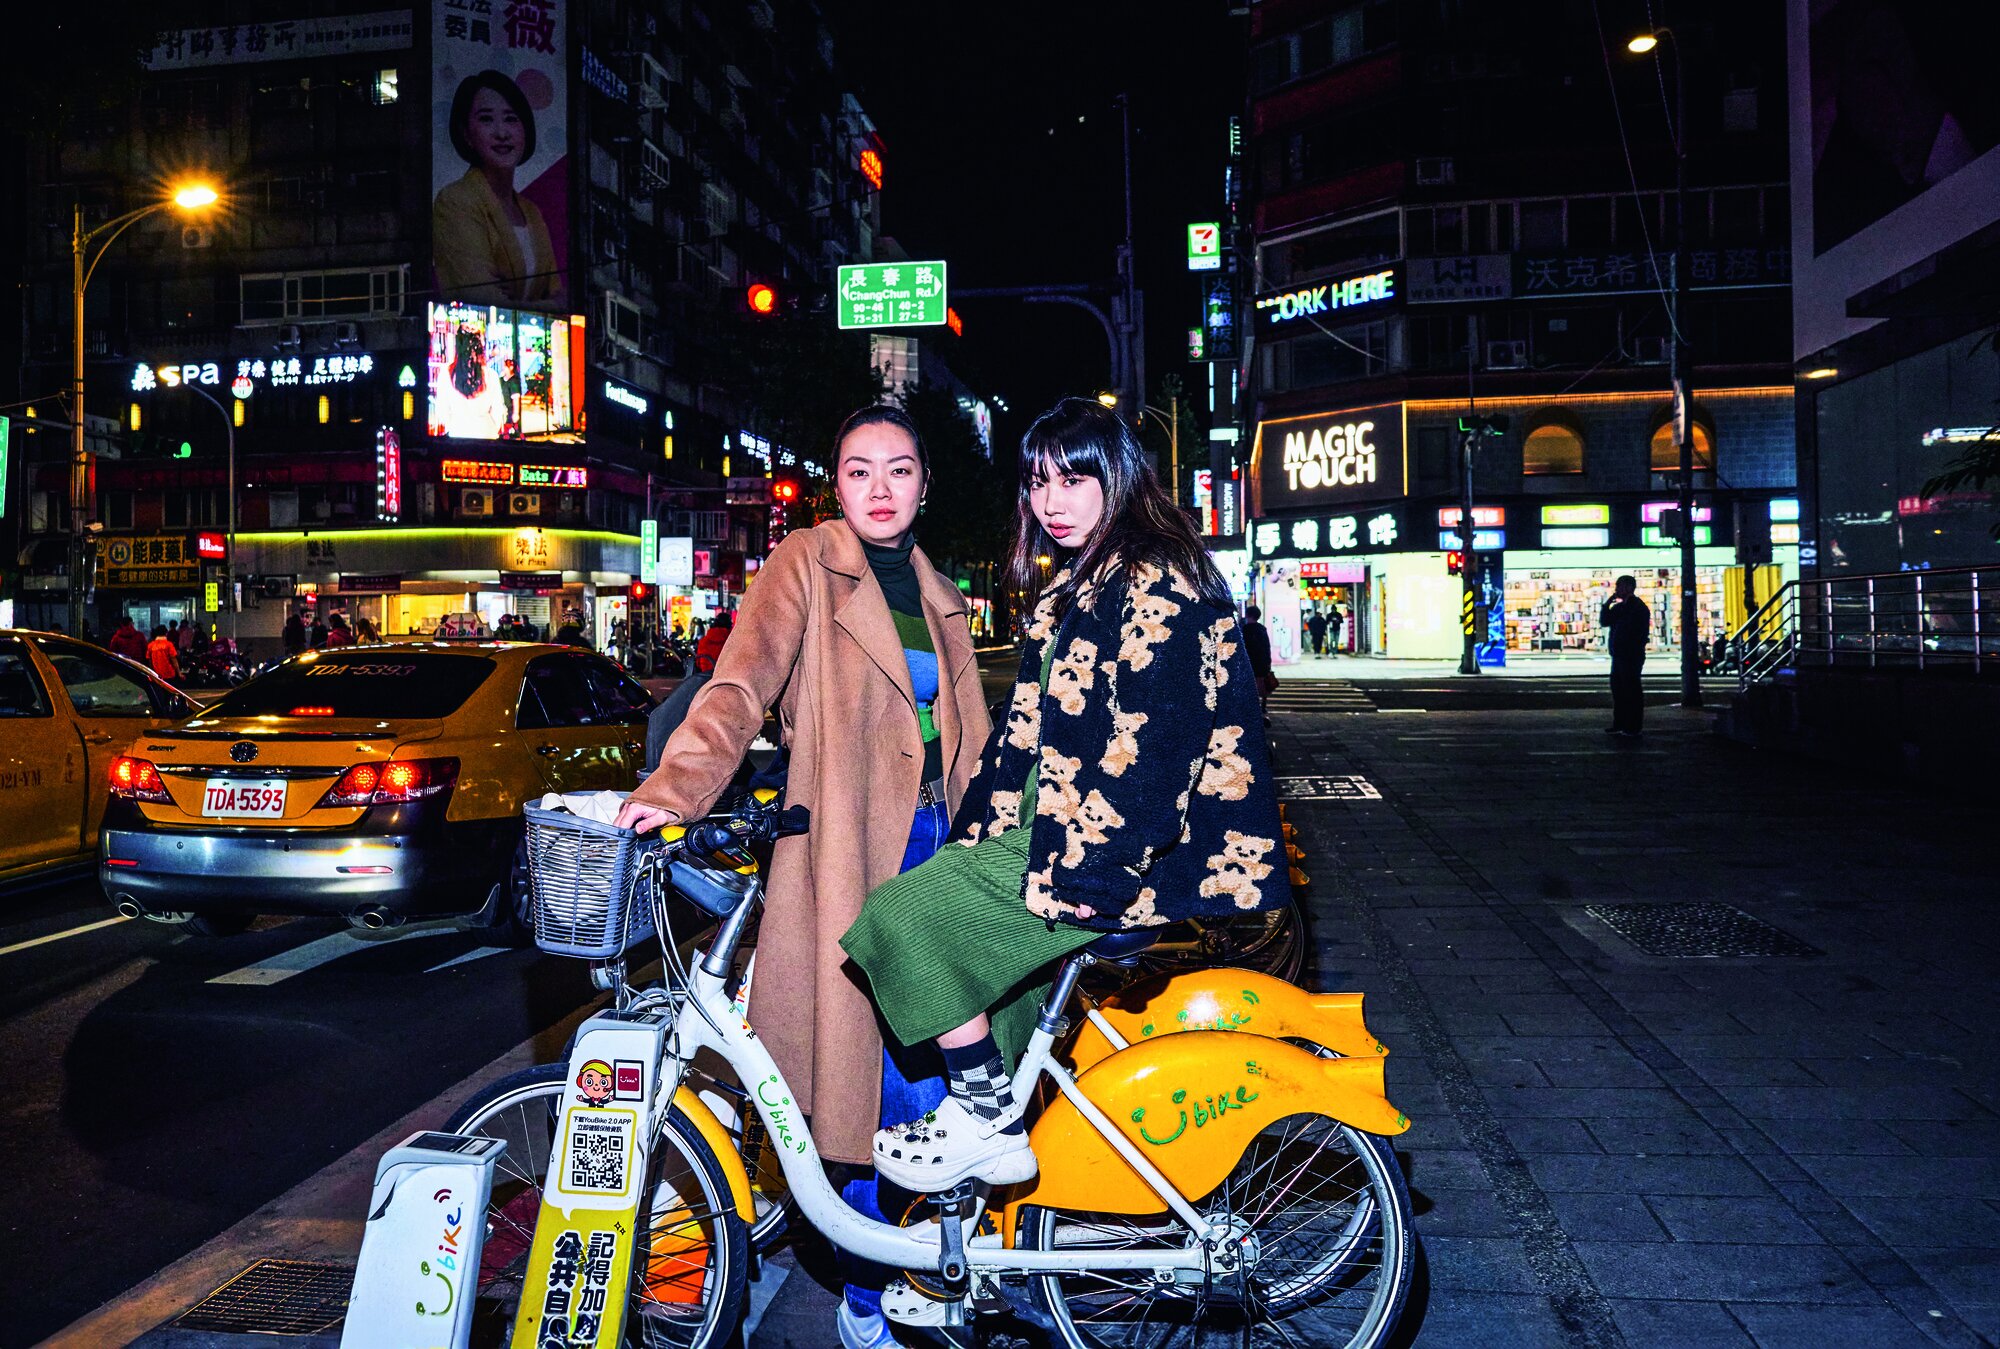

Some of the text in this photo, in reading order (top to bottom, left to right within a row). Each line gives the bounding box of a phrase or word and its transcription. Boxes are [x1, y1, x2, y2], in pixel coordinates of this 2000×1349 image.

[444, 14, 491, 45] 委員
[848, 266, 934, 288] 長春路
[849, 287, 935, 302] ChangChun Rd.
[1331, 269, 1394, 309] HERE
[898, 300, 925, 311] 40-2
[853, 313, 883, 324] 73-31
[520, 469, 549, 482] Eats
[1283, 452, 1376, 491] TOUCH
[305, 664, 417, 677] TDA-5393
[608, 1117, 618, 1125] 2.0
[538, 1231, 583, 1340] 公共自
[571, 1232, 615, 1340] 記得加
